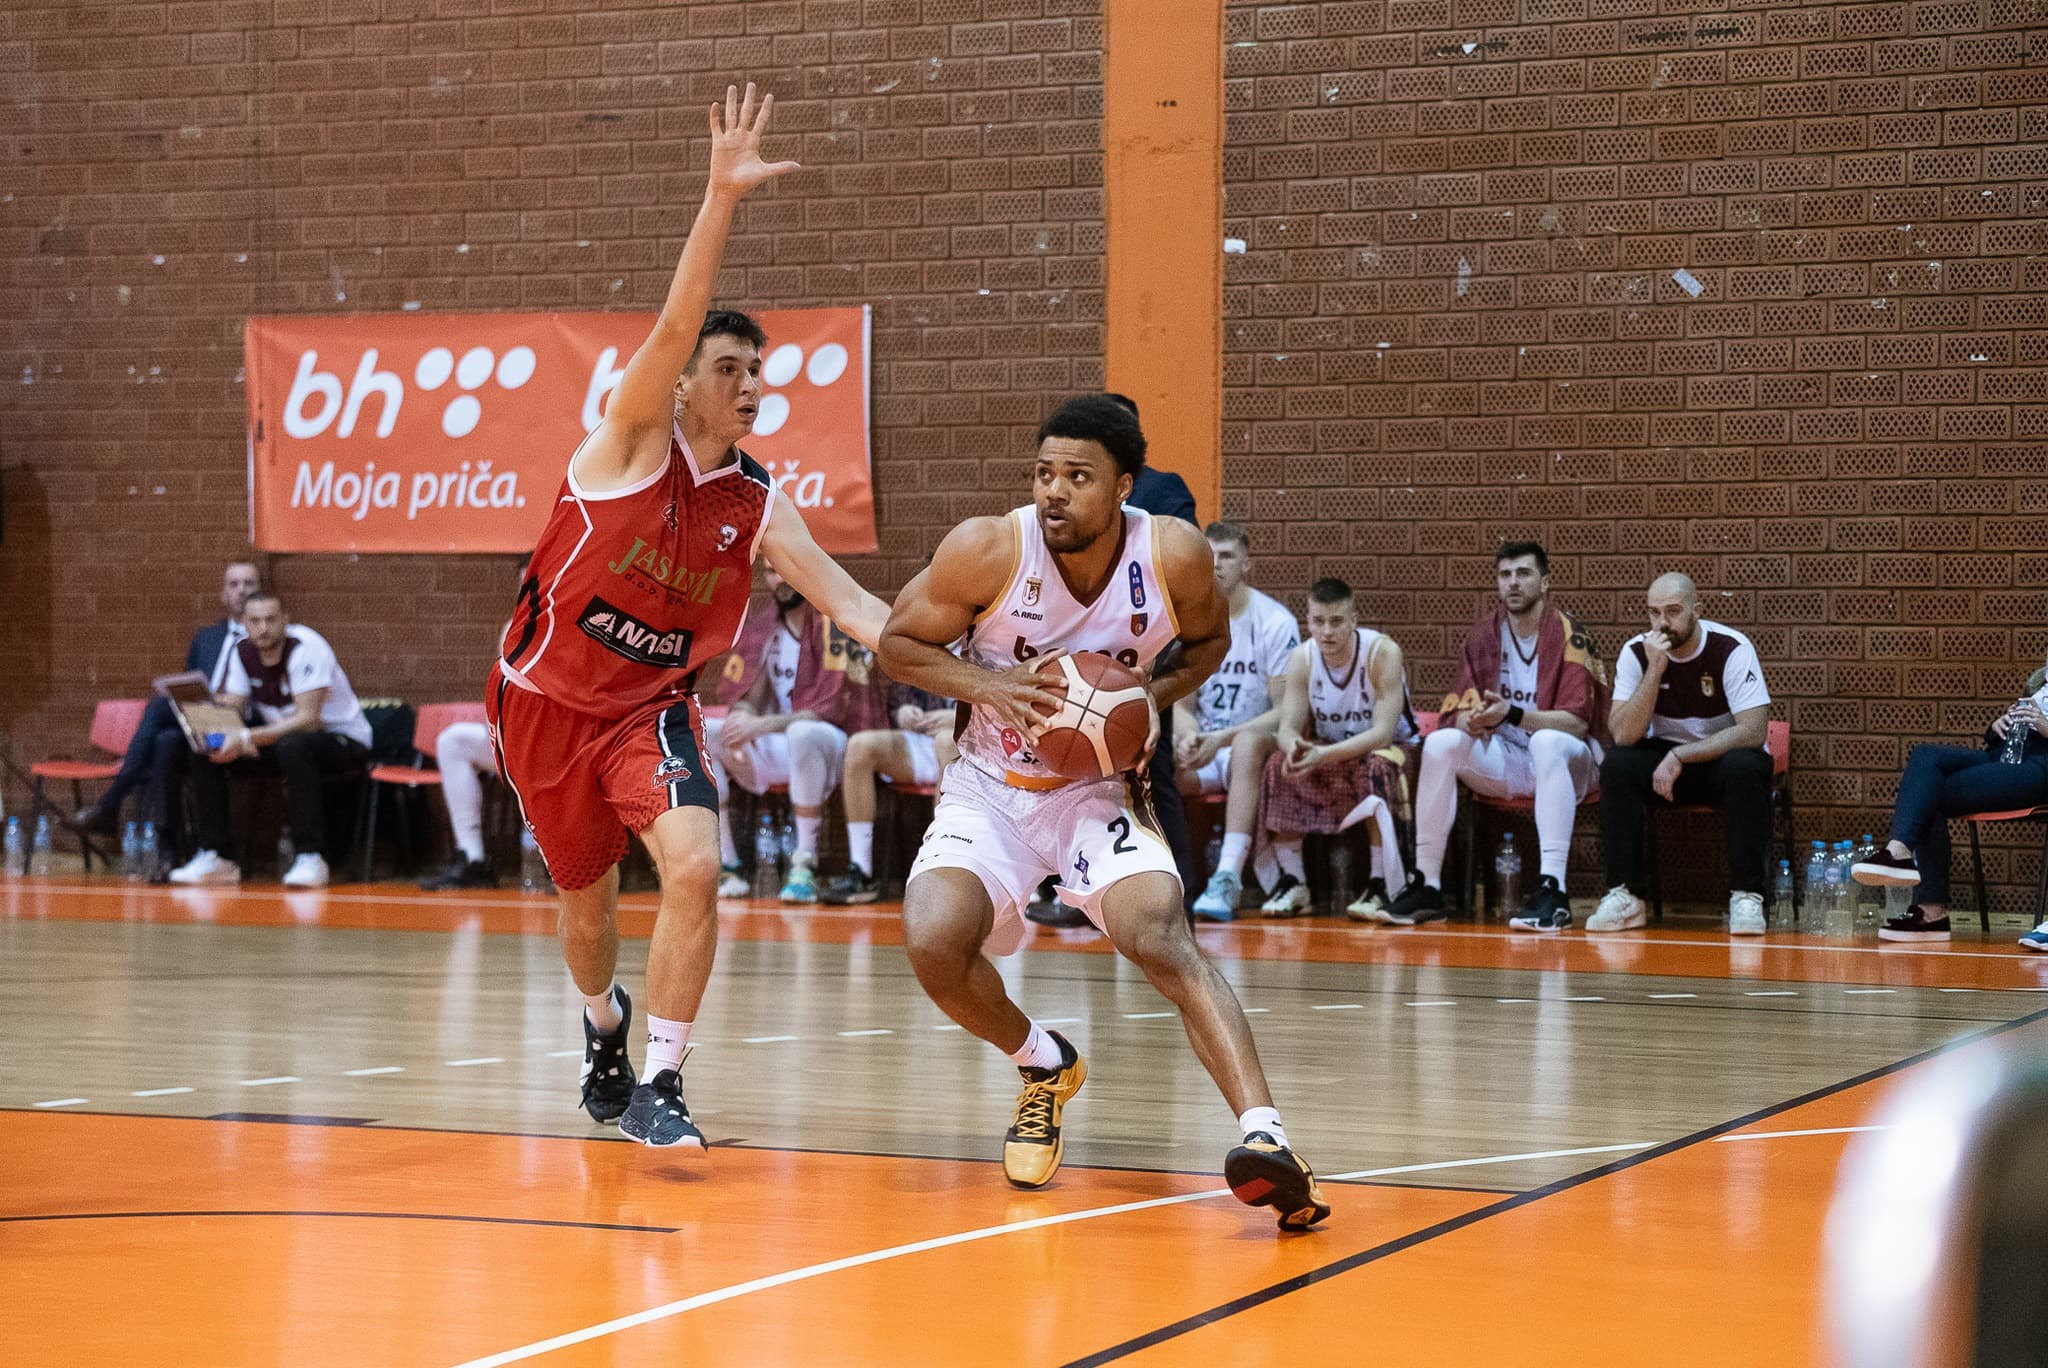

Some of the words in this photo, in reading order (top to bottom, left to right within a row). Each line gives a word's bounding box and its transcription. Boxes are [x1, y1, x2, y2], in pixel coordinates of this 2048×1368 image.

[283, 347, 404, 440] bh
[291, 461, 401, 521] Moja
[407, 460, 526, 521] priča.
[1021, 611, 1044, 621] ARDU
[1212, 683, 1241, 711] 27
[1004, 732, 1018, 746] SA
[1107, 815, 1139, 856] 2
